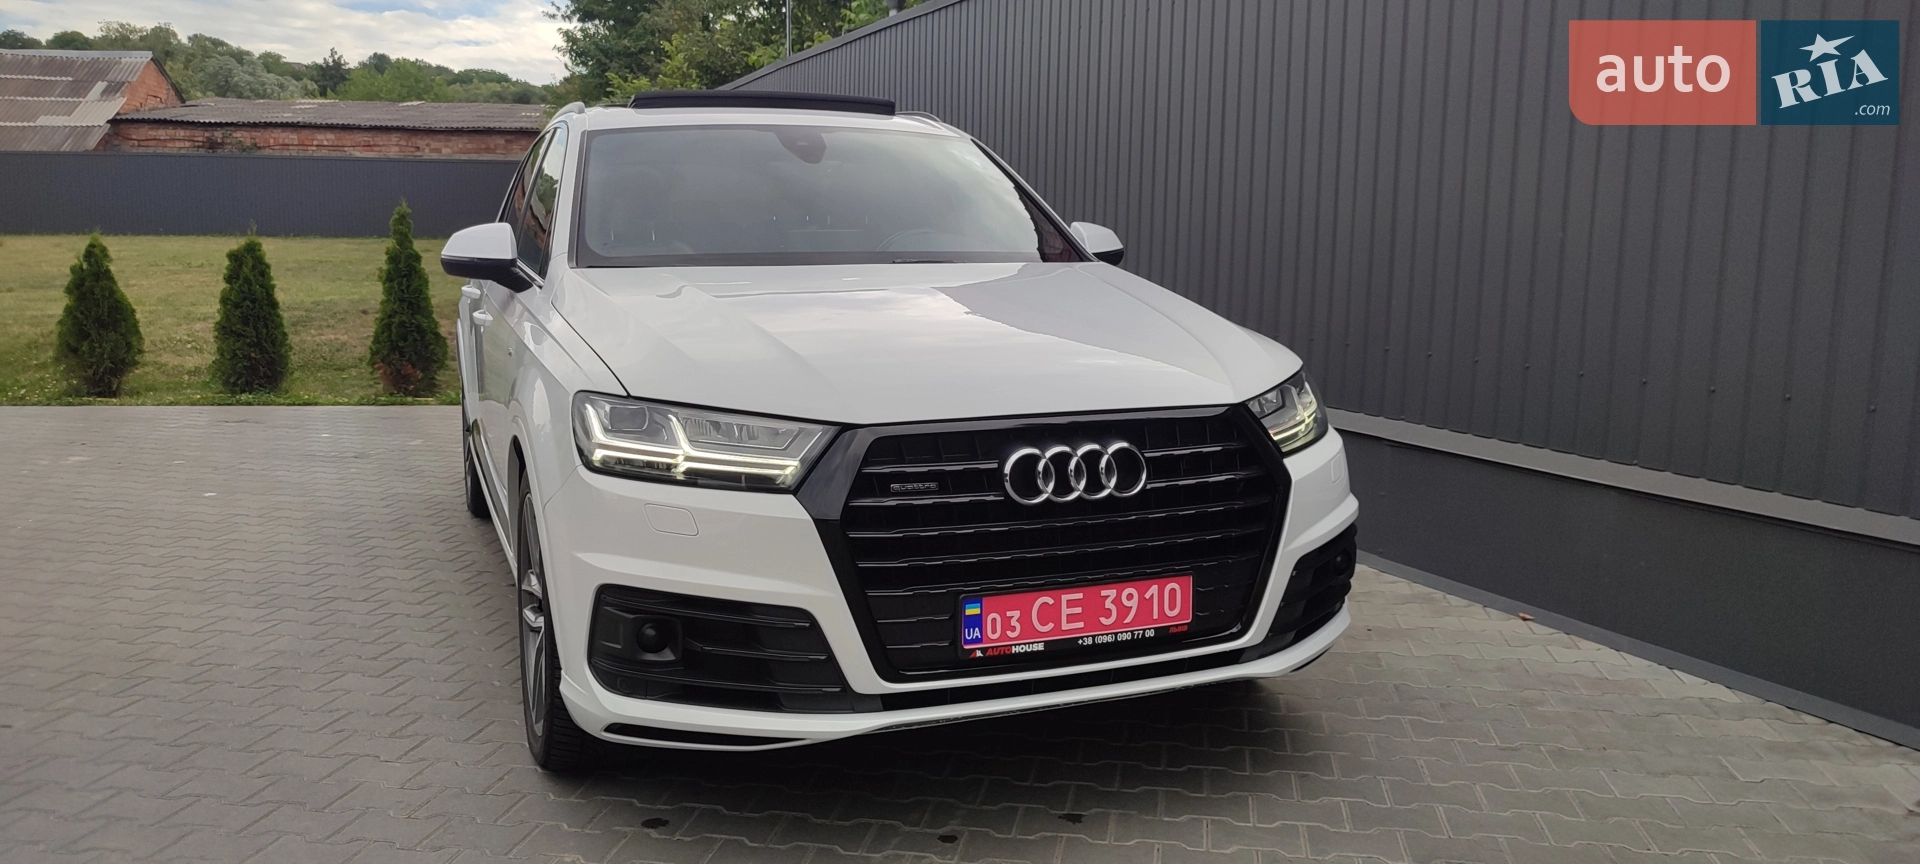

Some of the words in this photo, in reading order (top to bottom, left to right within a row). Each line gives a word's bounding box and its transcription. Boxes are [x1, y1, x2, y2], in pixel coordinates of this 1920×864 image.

[986, 610, 1021, 640] 03
[1031, 593, 1085, 633] CE
[1098, 582, 1182, 626] 3910
[965, 627, 981, 640] UA
[1078, 637, 1093, 645] +38
[1095, 634, 1115, 644] (096)
[1117, 632, 1132, 641] 090
[1133, 630, 1144, 639] 77
[1145, 629, 1155, 637] 00
[986, 642, 1045, 657] AUTOHOUSE
